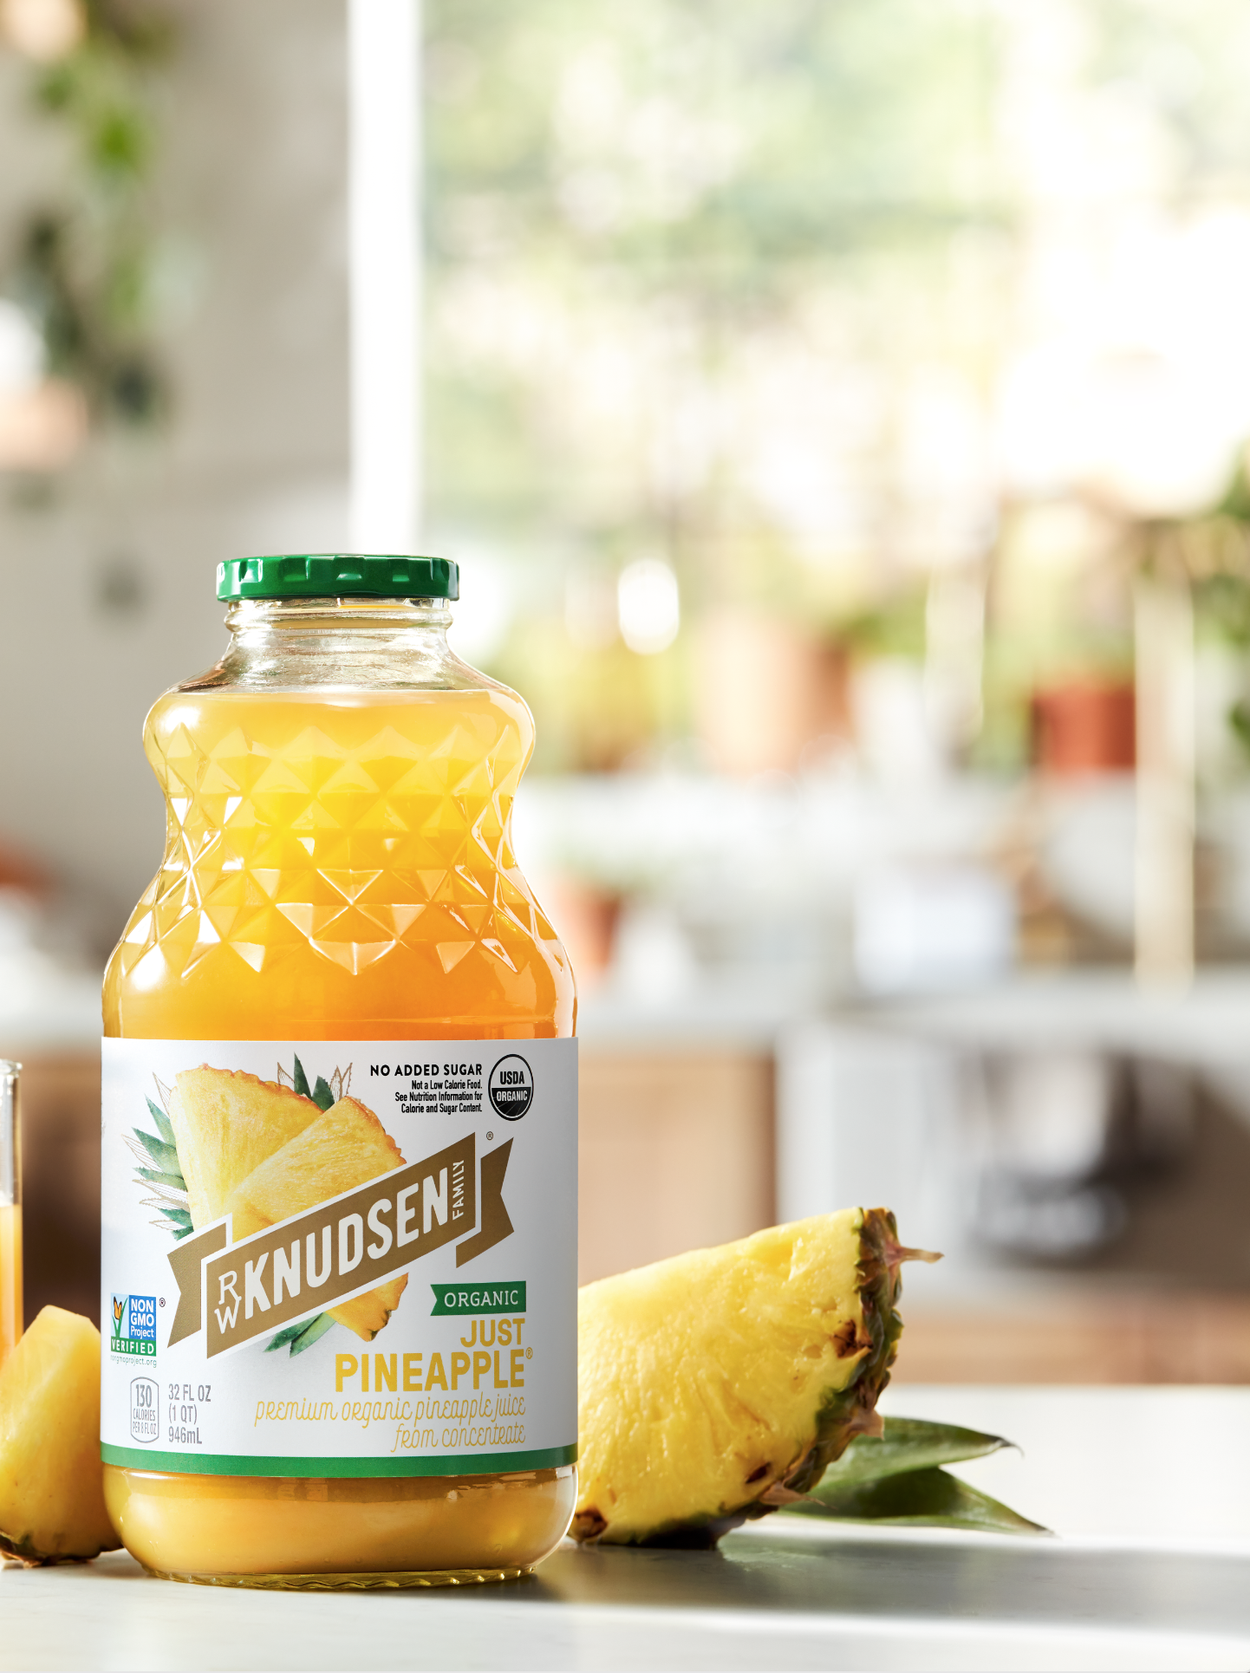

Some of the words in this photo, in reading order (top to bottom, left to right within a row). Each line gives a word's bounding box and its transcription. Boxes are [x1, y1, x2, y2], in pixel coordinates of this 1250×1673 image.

[370, 1064, 391, 1077] NO
[394, 1064, 440, 1076] ADDED
[443, 1063, 483, 1076] SUGAR
[411, 1080, 423, 1090] Not
[424, 1082, 429, 1090] a
[429, 1080, 443, 1090] Low
[444, 1079, 466, 1090] Calorie
[466, 1079, 483, 1089] Food.
[499, 1071, 525, 1085] USDA
[394, 1092, 408, 1102] See
[409, 1091, 437, 1101] Nutrition
[438, 1091, 473, 1101] Information
[473, 1091, 483, 1101] for
[496, 1090, 528, 1102] ORGANIC
[401, 1103, 425, 1113] Calorie
[425, 1103, 438, 1113] and
[439, 1103, 458, 1115] Sugar
[458, 1103, 483, 1113] Content.
[244, 1167, 448, 1320] KNUDSEN
[452, 1159, 465, 1221] FAMILY
[130, 1298, 154, 1312] NON
[443, 1290, 519, 1308] ORGANIC
[130, 1313, 155, 1327] GMO
[130, 1325, 155, 1339] Project
[460, 1317, 526, 1348] JUST
[111, 1338, 155, 1354] VERIFIED
[335, 1348, 525, 1392] PINEAPPLE
[135, 1384, 152, 1407] 130
[168, 1383, 180, 1401] 32
[182, 1384, 194, 1402] FL
[197, 1384, 212, 1402] OZ
[132, 1408, 156, 1422] CALORIES
[168, 1402, 177, 1424] (1
[180, 1403, 198, 1425] QT)
[254, 1397, 339, 1428] premium
[341, 1397, 413, 1429] organic
[414, 1391, 493, 1428] pineapple
[490, 1394, 526, 1423] juice
[132, 1421, 141, 1433] PER
[140, 1422, 145, 1434] 8
[144, 1422, 150, 1434] FL
[150, 1423, 157, 1435] OZ
[168, 1426, 203, 1444] 946mL
[390, 1423, 439, 1453] from
[441, 1422, 526, 1449] concentrate
